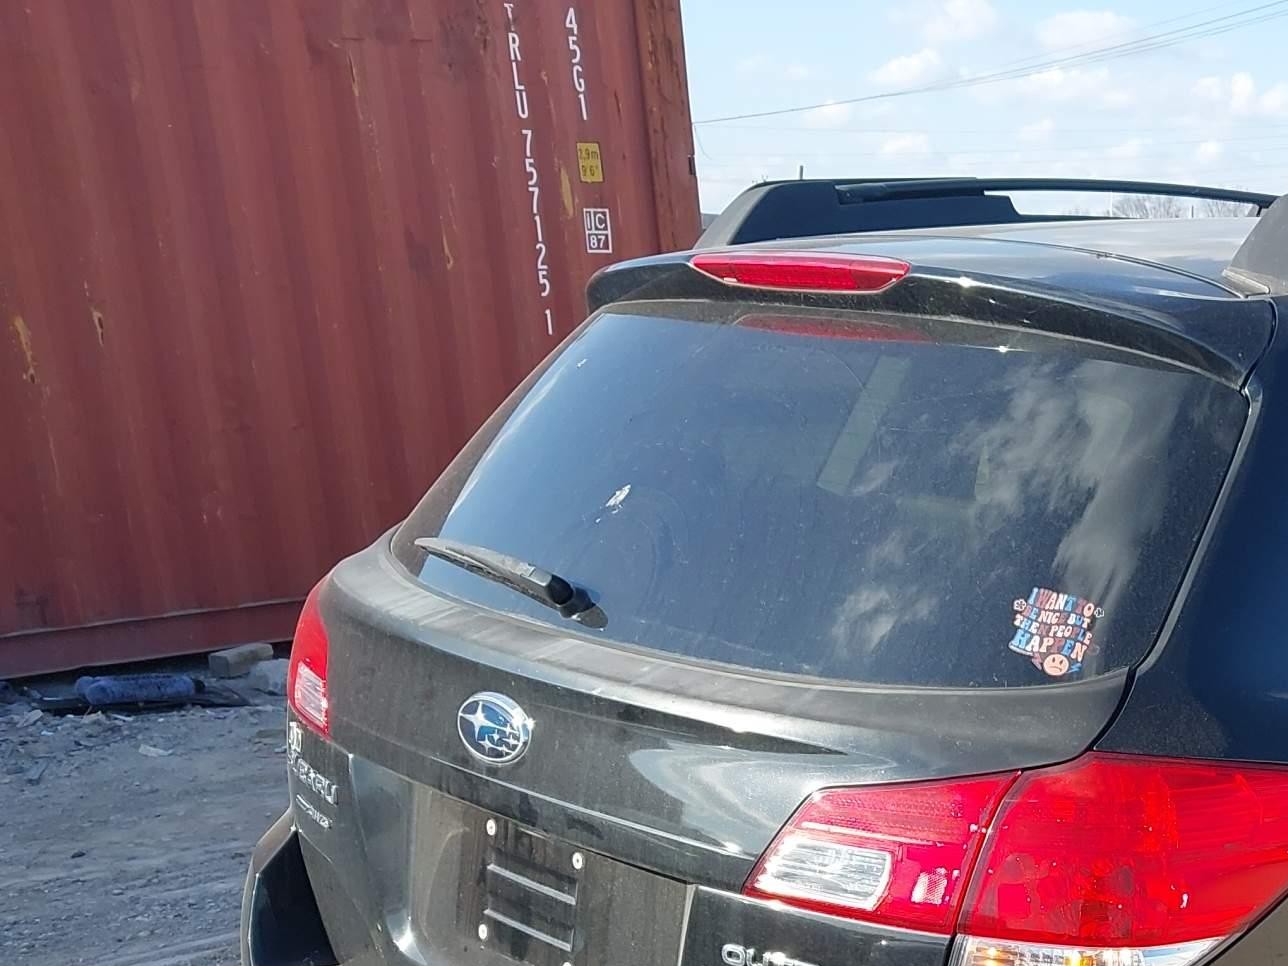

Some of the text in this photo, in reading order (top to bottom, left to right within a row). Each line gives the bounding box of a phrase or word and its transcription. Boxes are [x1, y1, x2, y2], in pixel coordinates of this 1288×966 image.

[565, 7, 588, 120] 45G1
[504, 3, 528, 119] TRLU
[522, 129, 550, 298] 757125
[589, 234, 606, 249] 87
[1028, 587, 1094, 617] I WANT TO
[1014, 614, 1093, 646] THEN PEOPLE
[1038, 611, 1067, 625] NICE
[1067, 613, 1091, 628] BUT
[1013, 629, 1088, 662] HAPPEN
